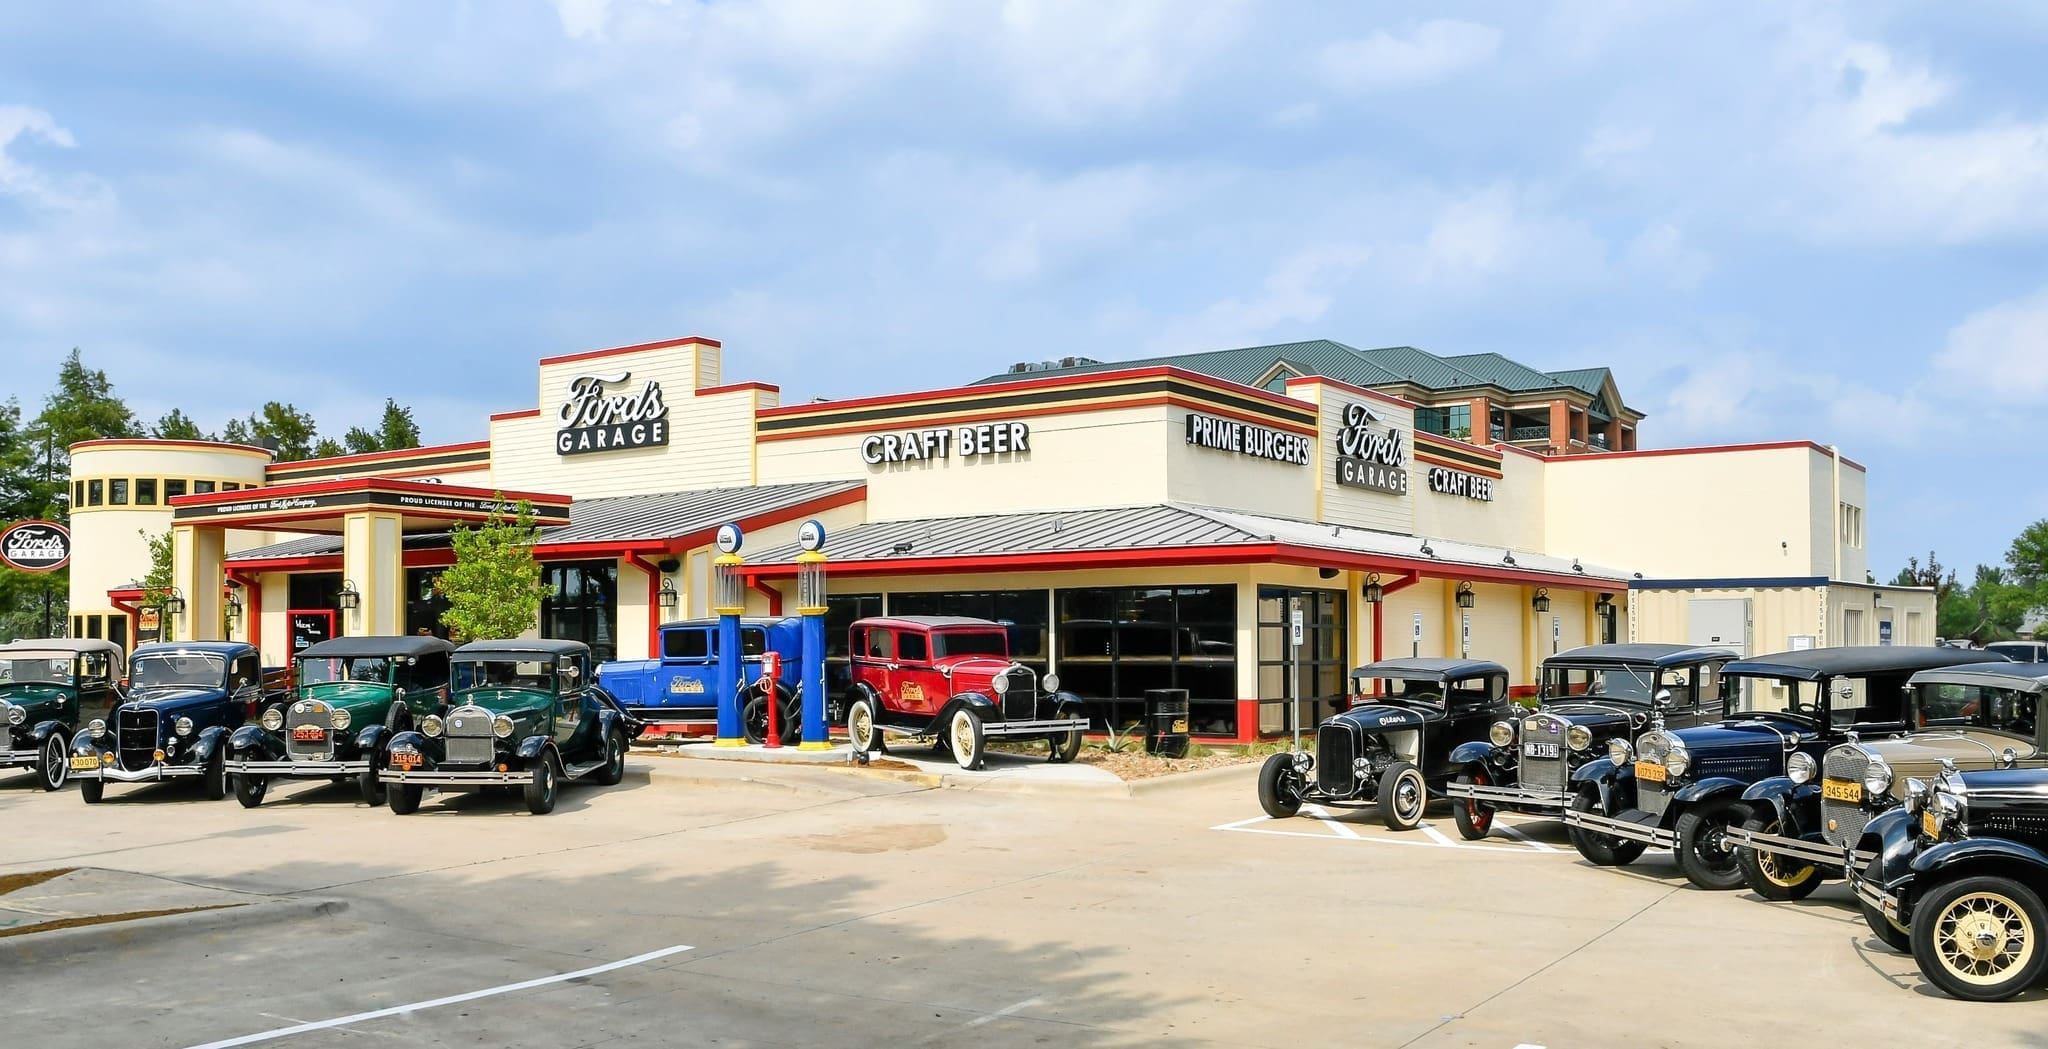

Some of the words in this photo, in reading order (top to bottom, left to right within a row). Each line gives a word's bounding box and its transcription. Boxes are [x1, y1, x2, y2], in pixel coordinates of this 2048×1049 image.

[558, 371, 669, 428] Ford's
[559, 422, 662, 452] GARAGE
[861, 429, 953, 465] CRAFT
[958, 422, 1029, 457] BEER
[1186, 414, 1241, 452] PRIME
[1244, 425, 1310, 466] BURGERS
[1337, 402, 1406, 467] Ford's
[1343, 461, 1407, 493] GARAGE
[1430, 468, 1469, 497] CRAFT
[1469, 476, 1494, 502] BEER
[400, 496, 423, 504] PROUD
[424, 498, 453, 507] LICENSEE
[8, 529, 64, 549] Ford's
[10, 550, 63, 558] GARAGE
